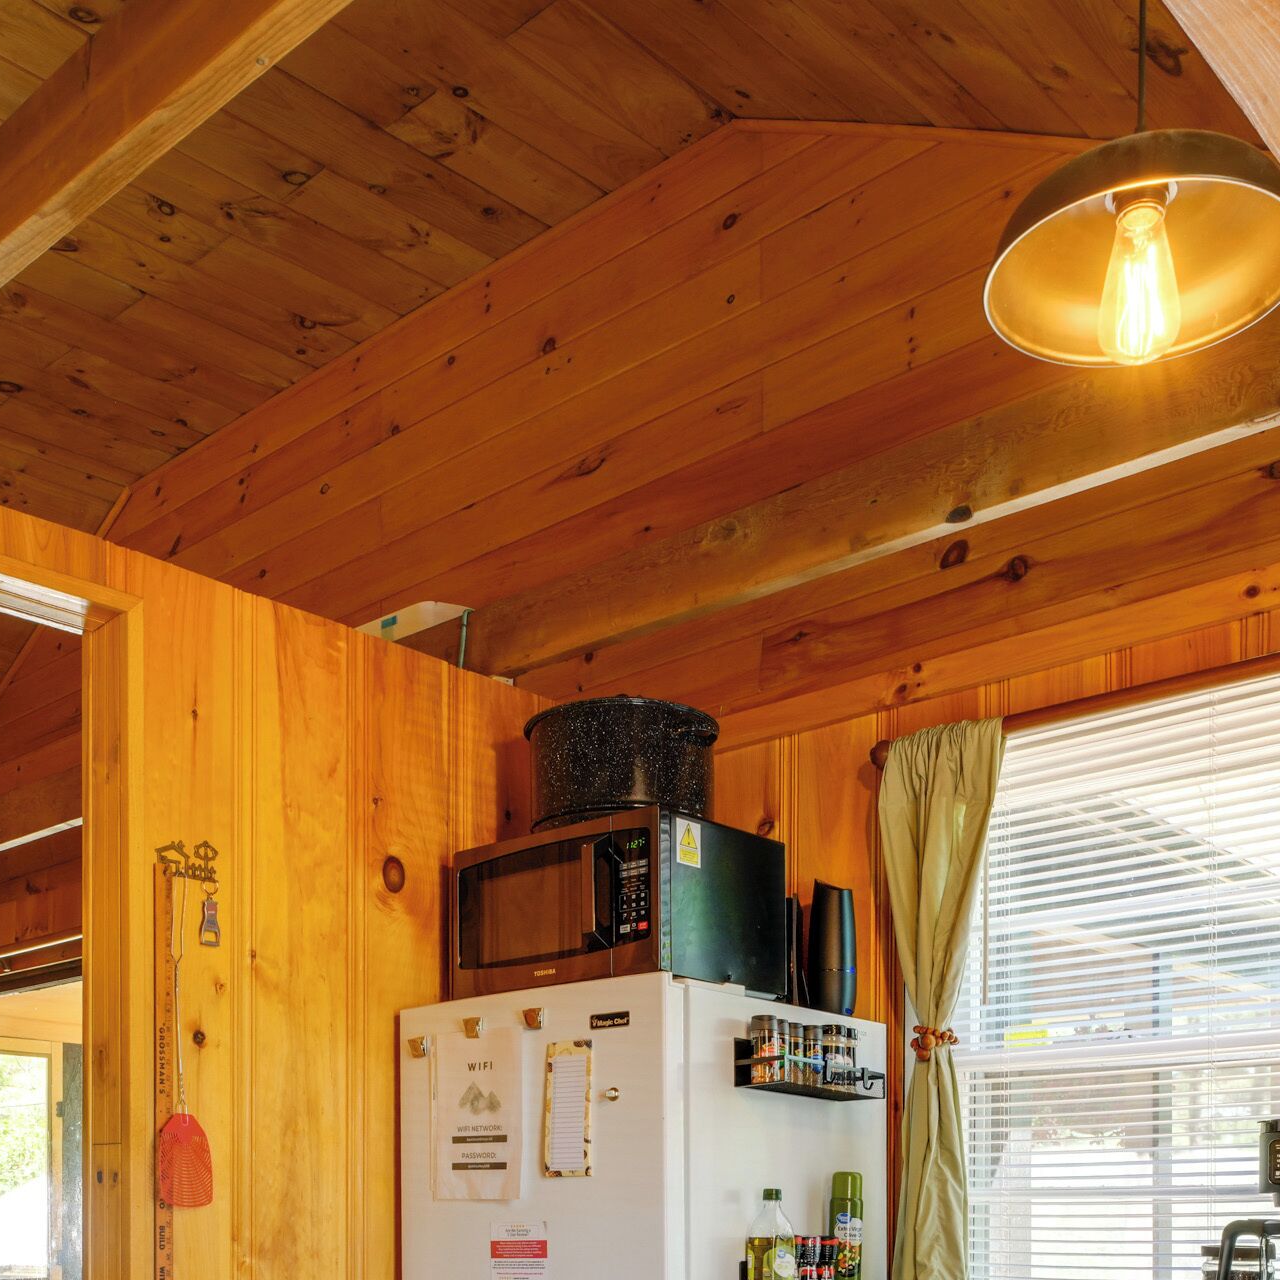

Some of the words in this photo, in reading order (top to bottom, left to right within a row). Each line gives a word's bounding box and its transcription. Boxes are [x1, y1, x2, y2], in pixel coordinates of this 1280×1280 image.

[533, 968, 557, 977] TOSHIBA
[596, 1018, 613, 1027] Magic
[614, 1016, 628, 1025] Chef
[467, 1060, 494, 1072] WIFI
[457, 1125, 471, 1133] WIFI
[471, 1124, 503, 1132] NETWORK:
[461, 1151, 497, 1159] PASSWORD:
